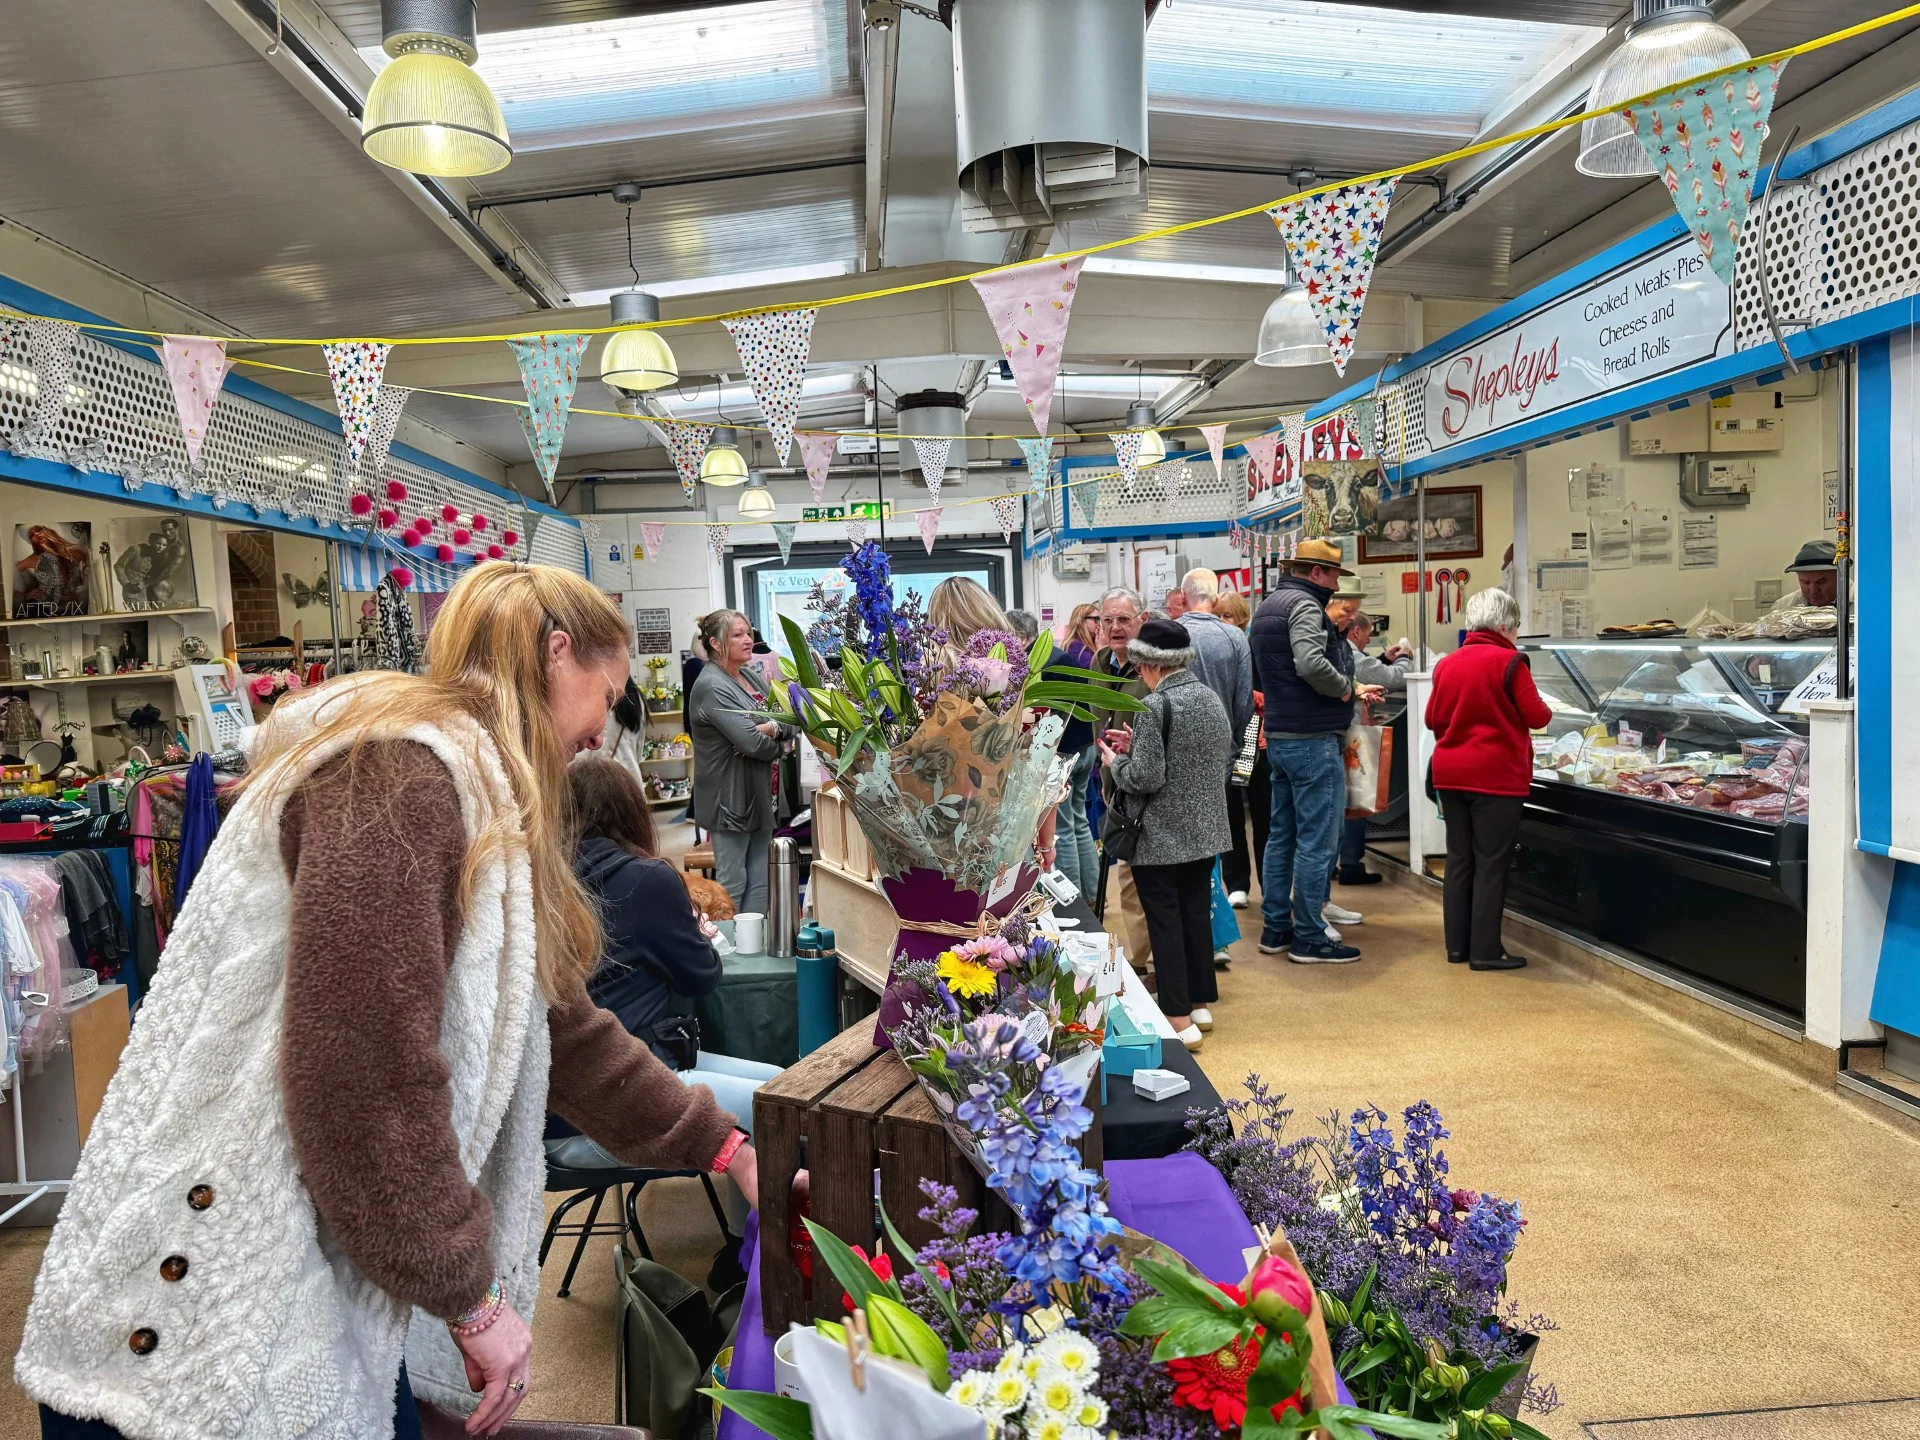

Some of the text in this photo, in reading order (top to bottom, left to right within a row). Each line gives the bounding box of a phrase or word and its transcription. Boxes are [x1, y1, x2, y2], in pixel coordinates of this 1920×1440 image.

[1584, 254, 1704, 322] Cooked Meats Pies
[1599, 299, 1675, 347] Cheeses and
[1603, 336, 1670, 376] Bread Rolls
[1442, 333, 1560, 440] Shepleys
[789, 576, 810, 588] Veg
[1218, 567, 1262, 594] ALE
[16, 601, 84, 618] AFTER SIX
[1795, 686, 1831, 700] Here
